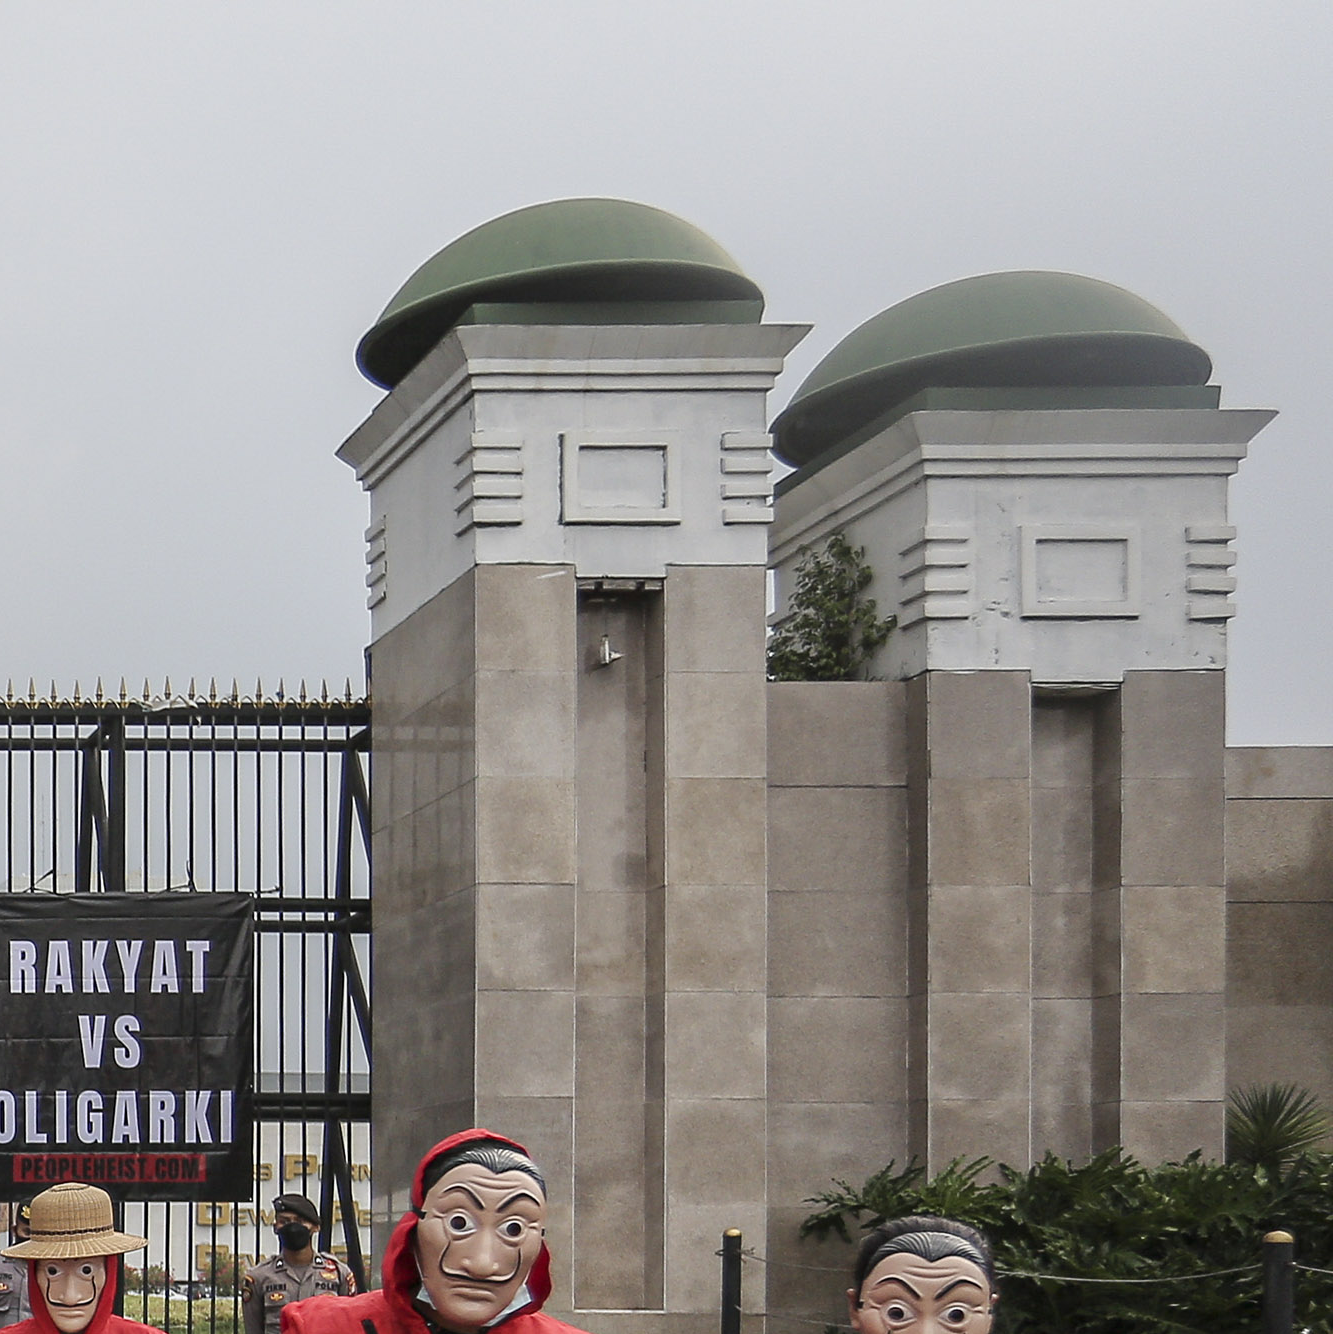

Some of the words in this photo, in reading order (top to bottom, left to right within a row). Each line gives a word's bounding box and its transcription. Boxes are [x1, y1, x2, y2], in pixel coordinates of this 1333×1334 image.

[9, 940, 210, 994] RAKYAT
[78, 1014, 142, 1069] VS
[20, 1155, 200, 1181] PEOPLEHEIST.COM
